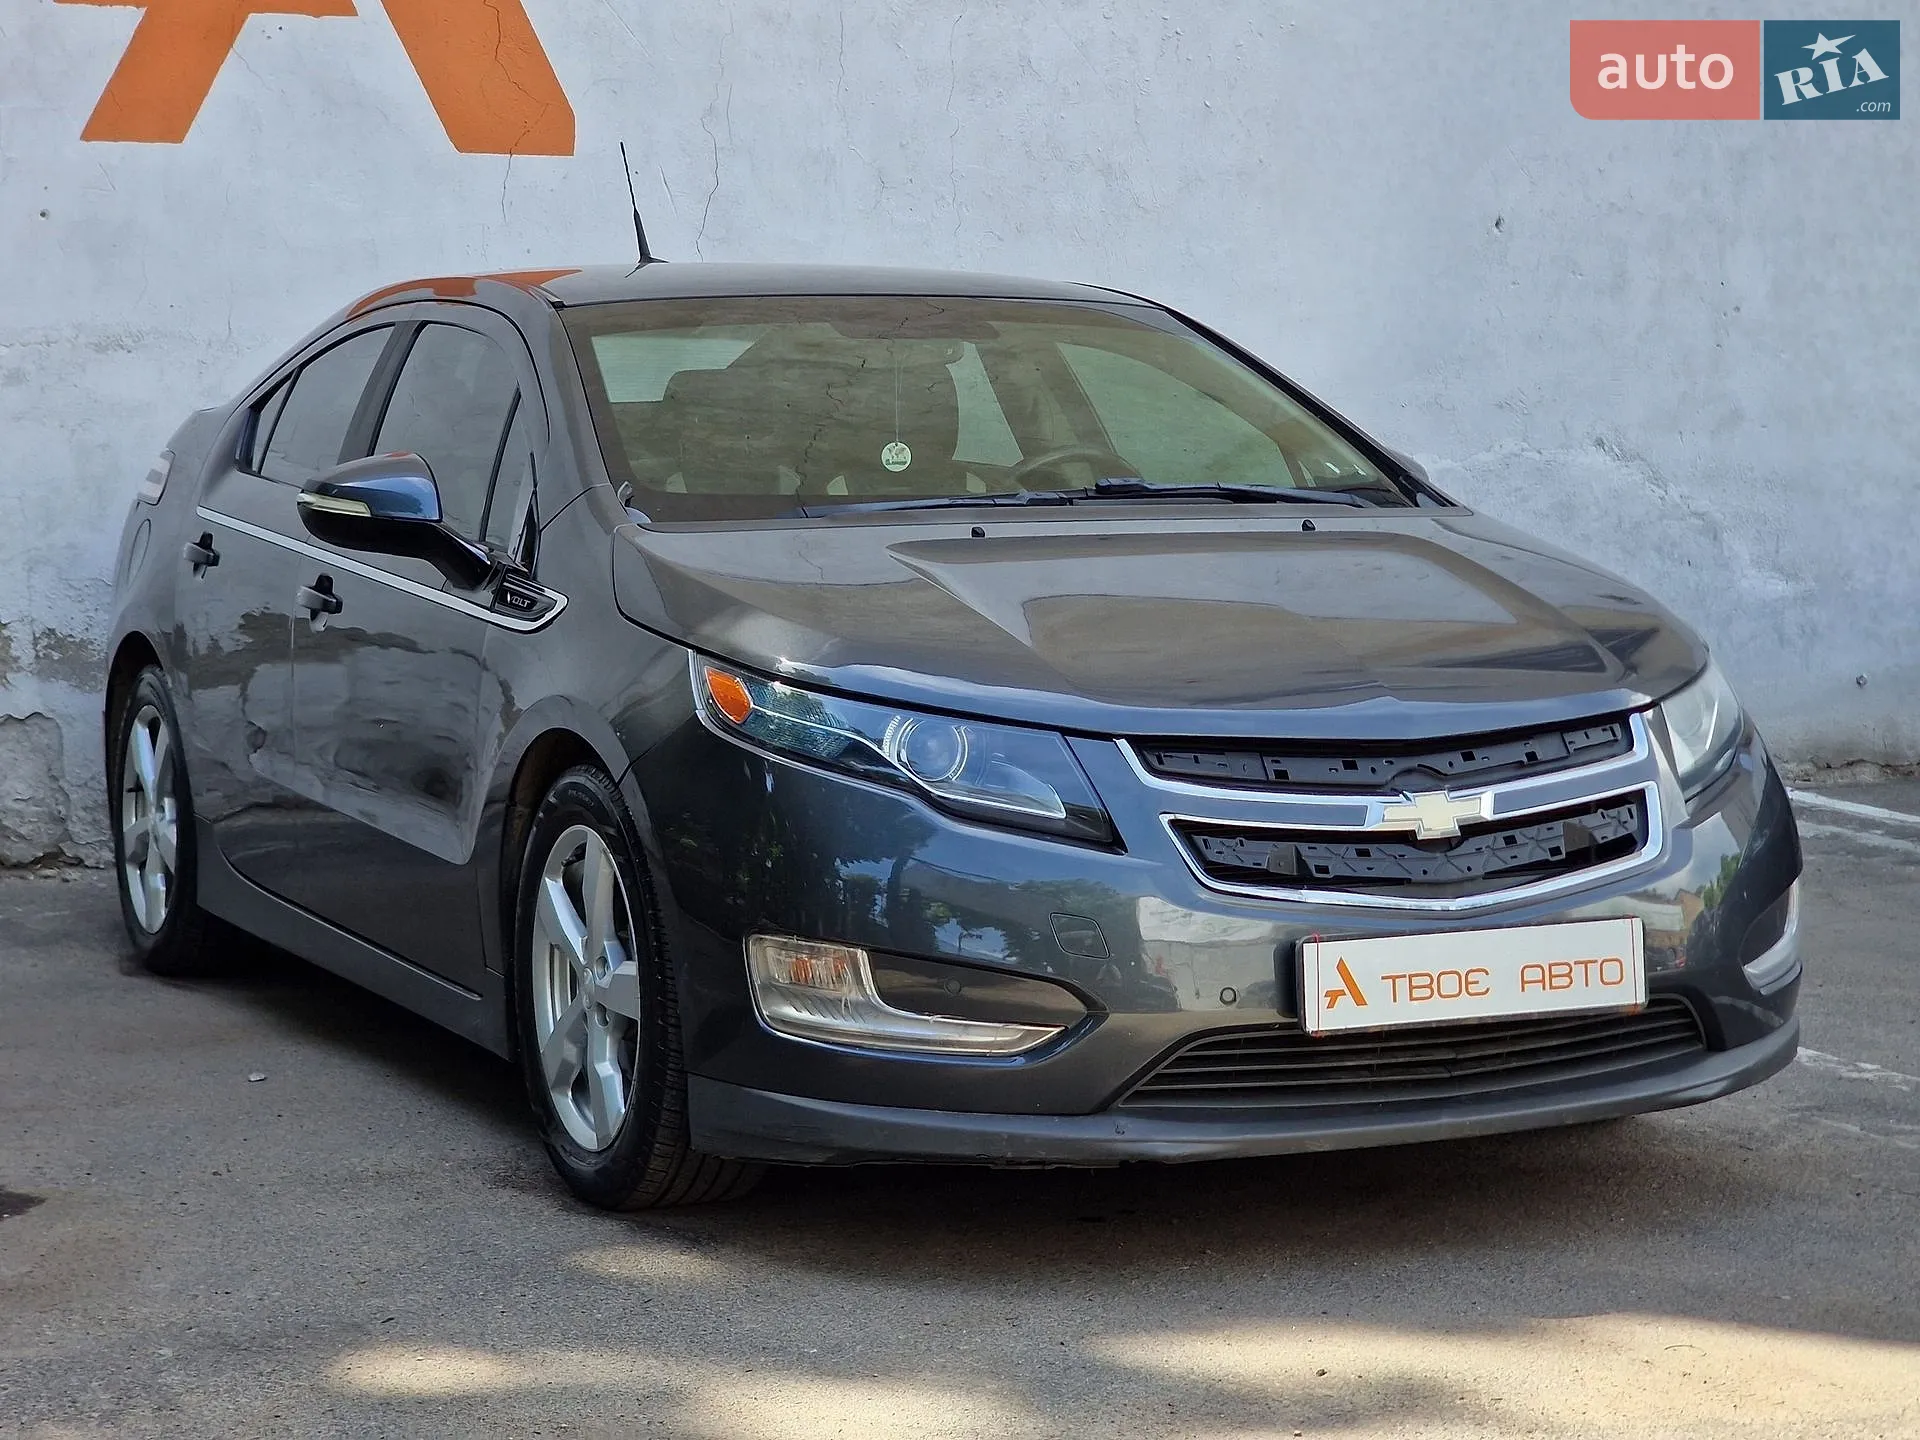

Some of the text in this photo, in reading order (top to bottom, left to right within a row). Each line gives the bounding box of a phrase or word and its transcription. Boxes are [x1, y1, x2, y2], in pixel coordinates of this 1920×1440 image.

[506, 591, 531, 608] VOLT
[1380, 967, 1490, 1004] ТВОЄ
[1519, 957, 1625, 993] АВТО
